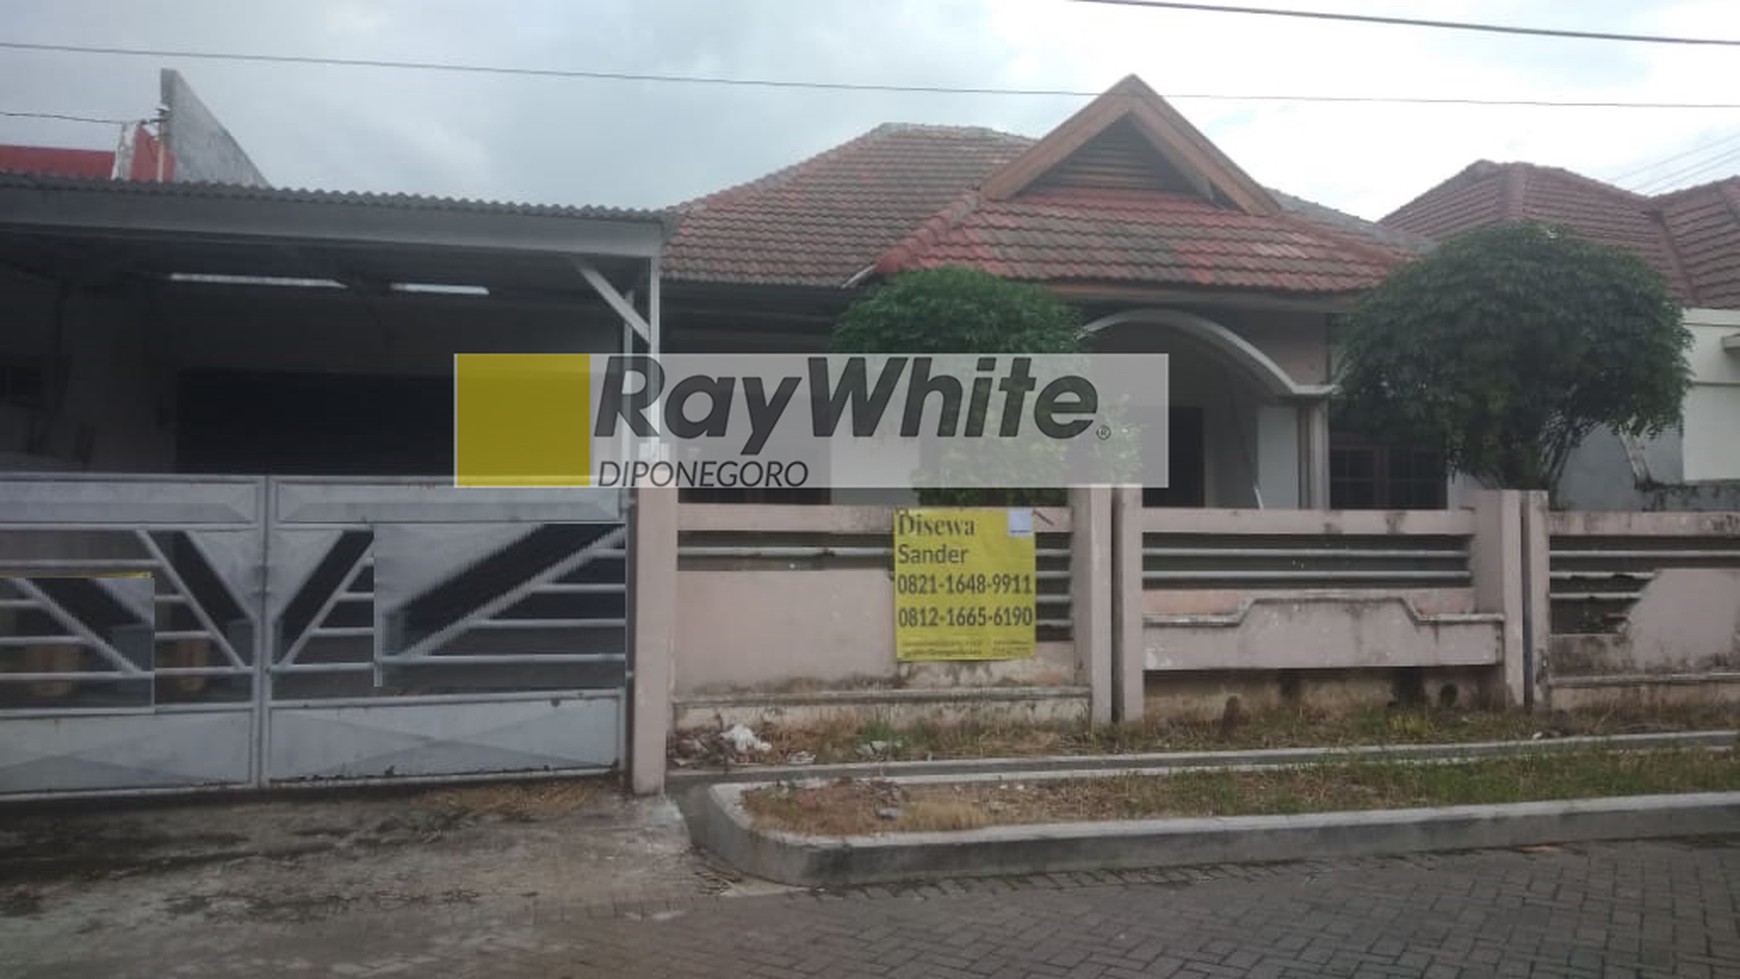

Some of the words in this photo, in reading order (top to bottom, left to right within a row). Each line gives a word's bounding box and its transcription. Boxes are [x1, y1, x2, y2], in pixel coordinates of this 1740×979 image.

[898, 513, 975, 536] Disewa
[898, 543, 969, 565] Sander
[898, 573, 1032, 595] 0821-1648-9911
[898, 606, 1033, 627] 0812-1665-6190
